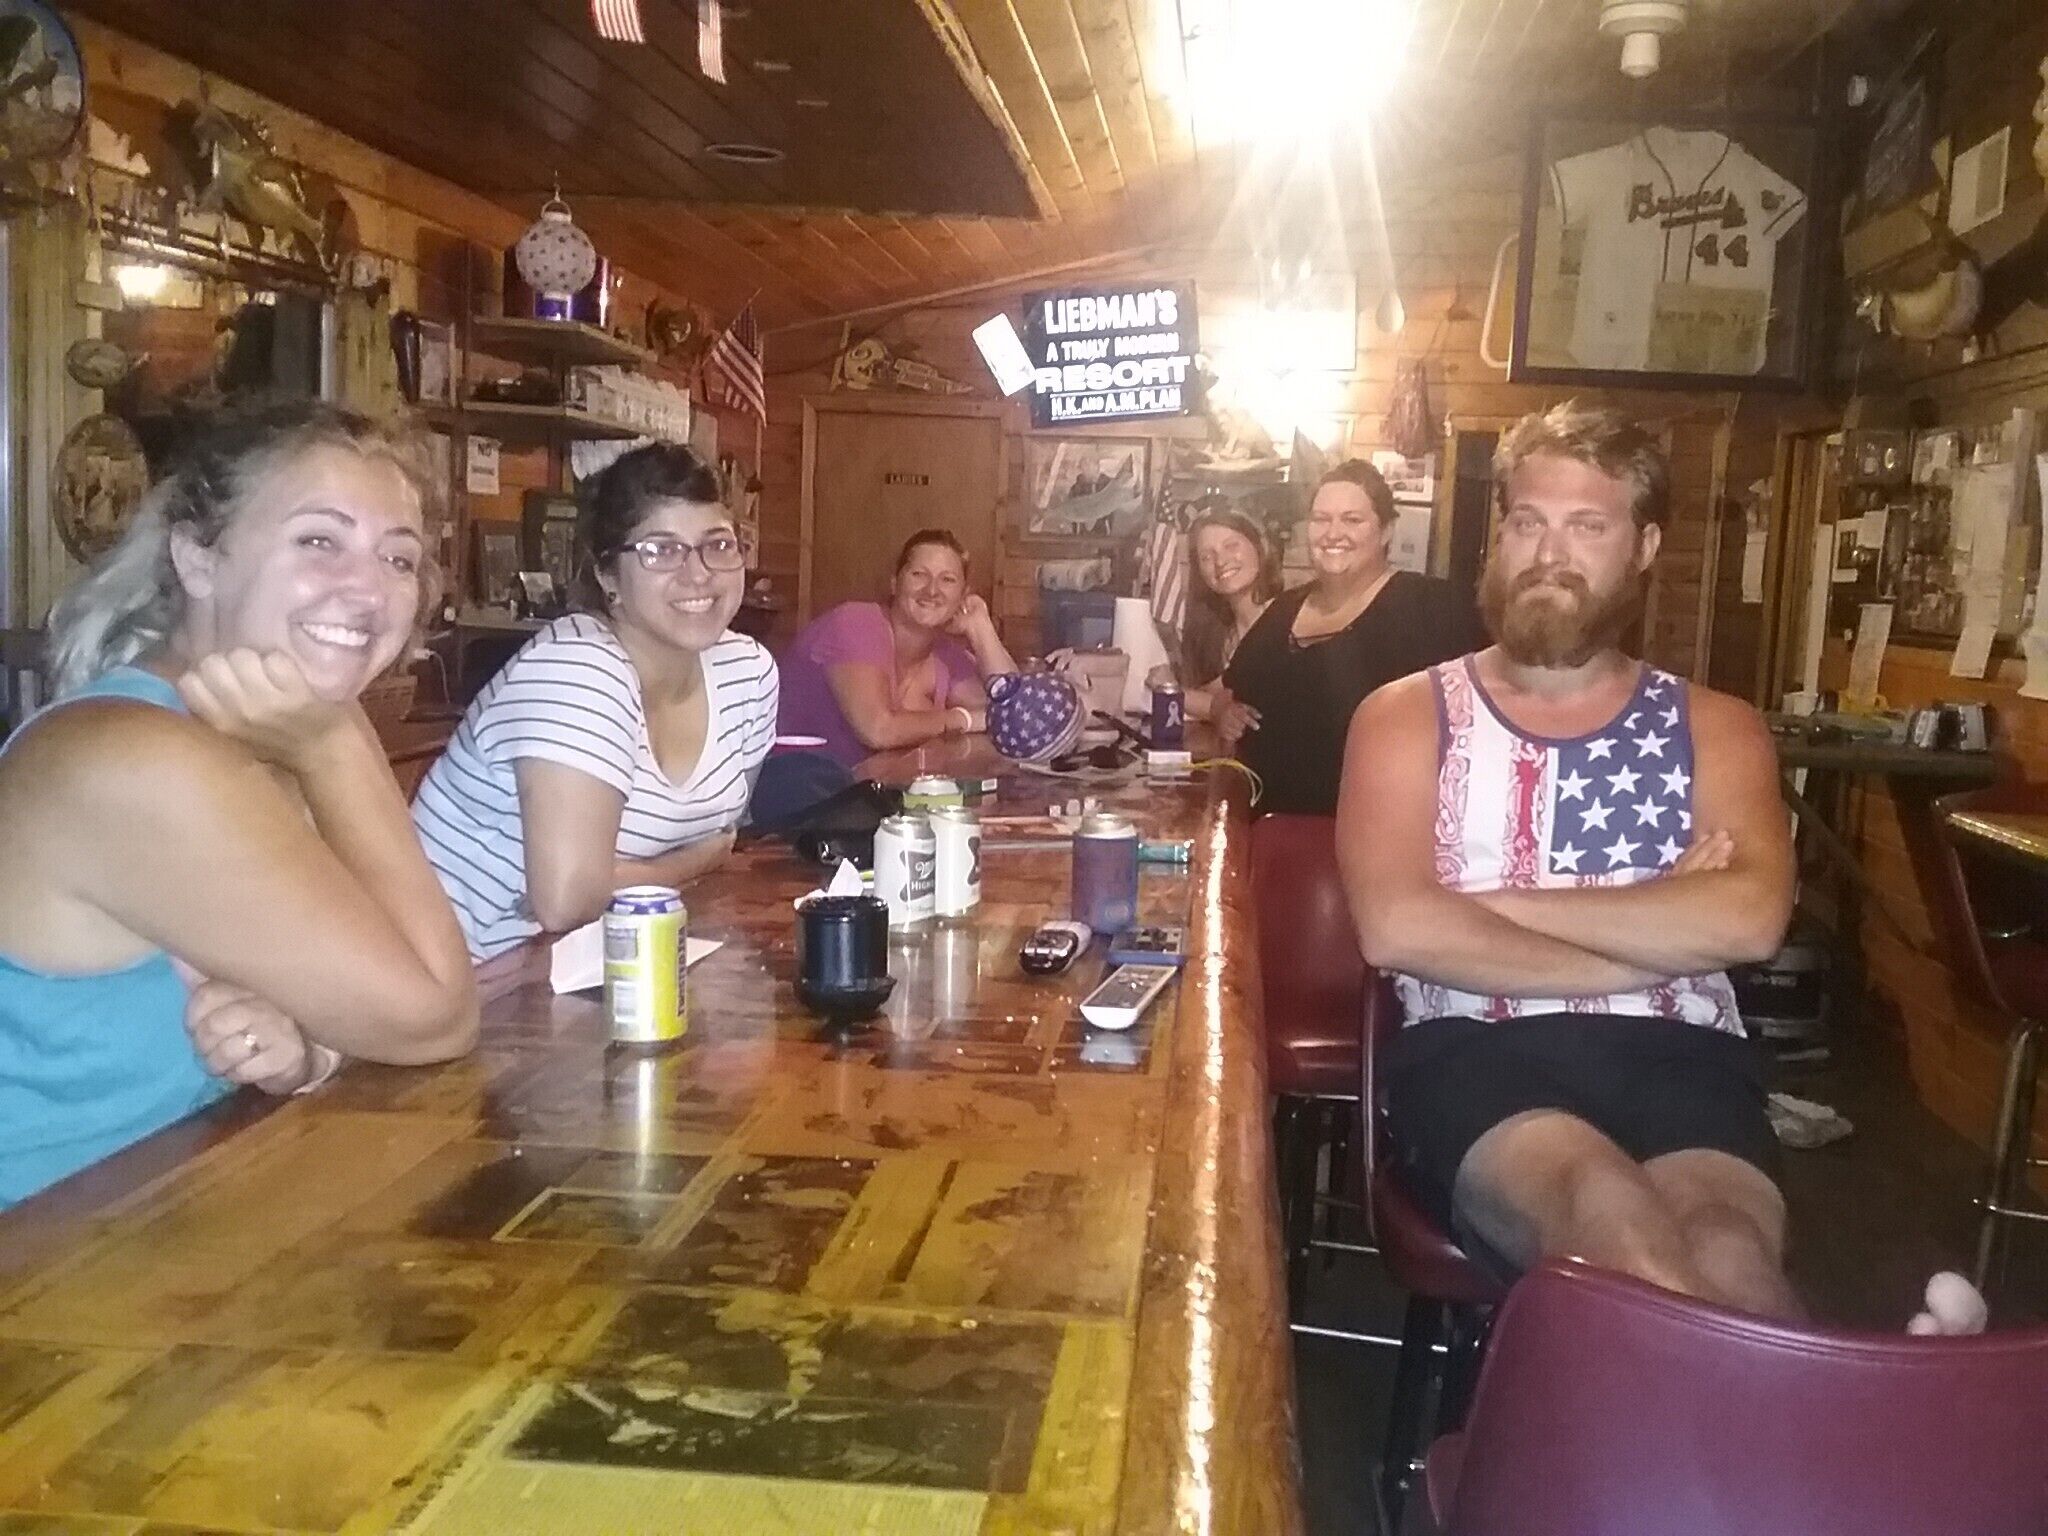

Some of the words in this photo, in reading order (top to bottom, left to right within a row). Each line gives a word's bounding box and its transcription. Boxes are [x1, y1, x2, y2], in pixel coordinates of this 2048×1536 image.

[1695, 233, 1748, 267] 44
[1044, 289, 1178, 334] LIEBMAN'S
[1046, 342, 1059, 362] A
[1061, 338, 1110, 361] TRULY
[1035, 356, 1189, 394] RESORT
[1139, 388, 1181, 409] PLAN
